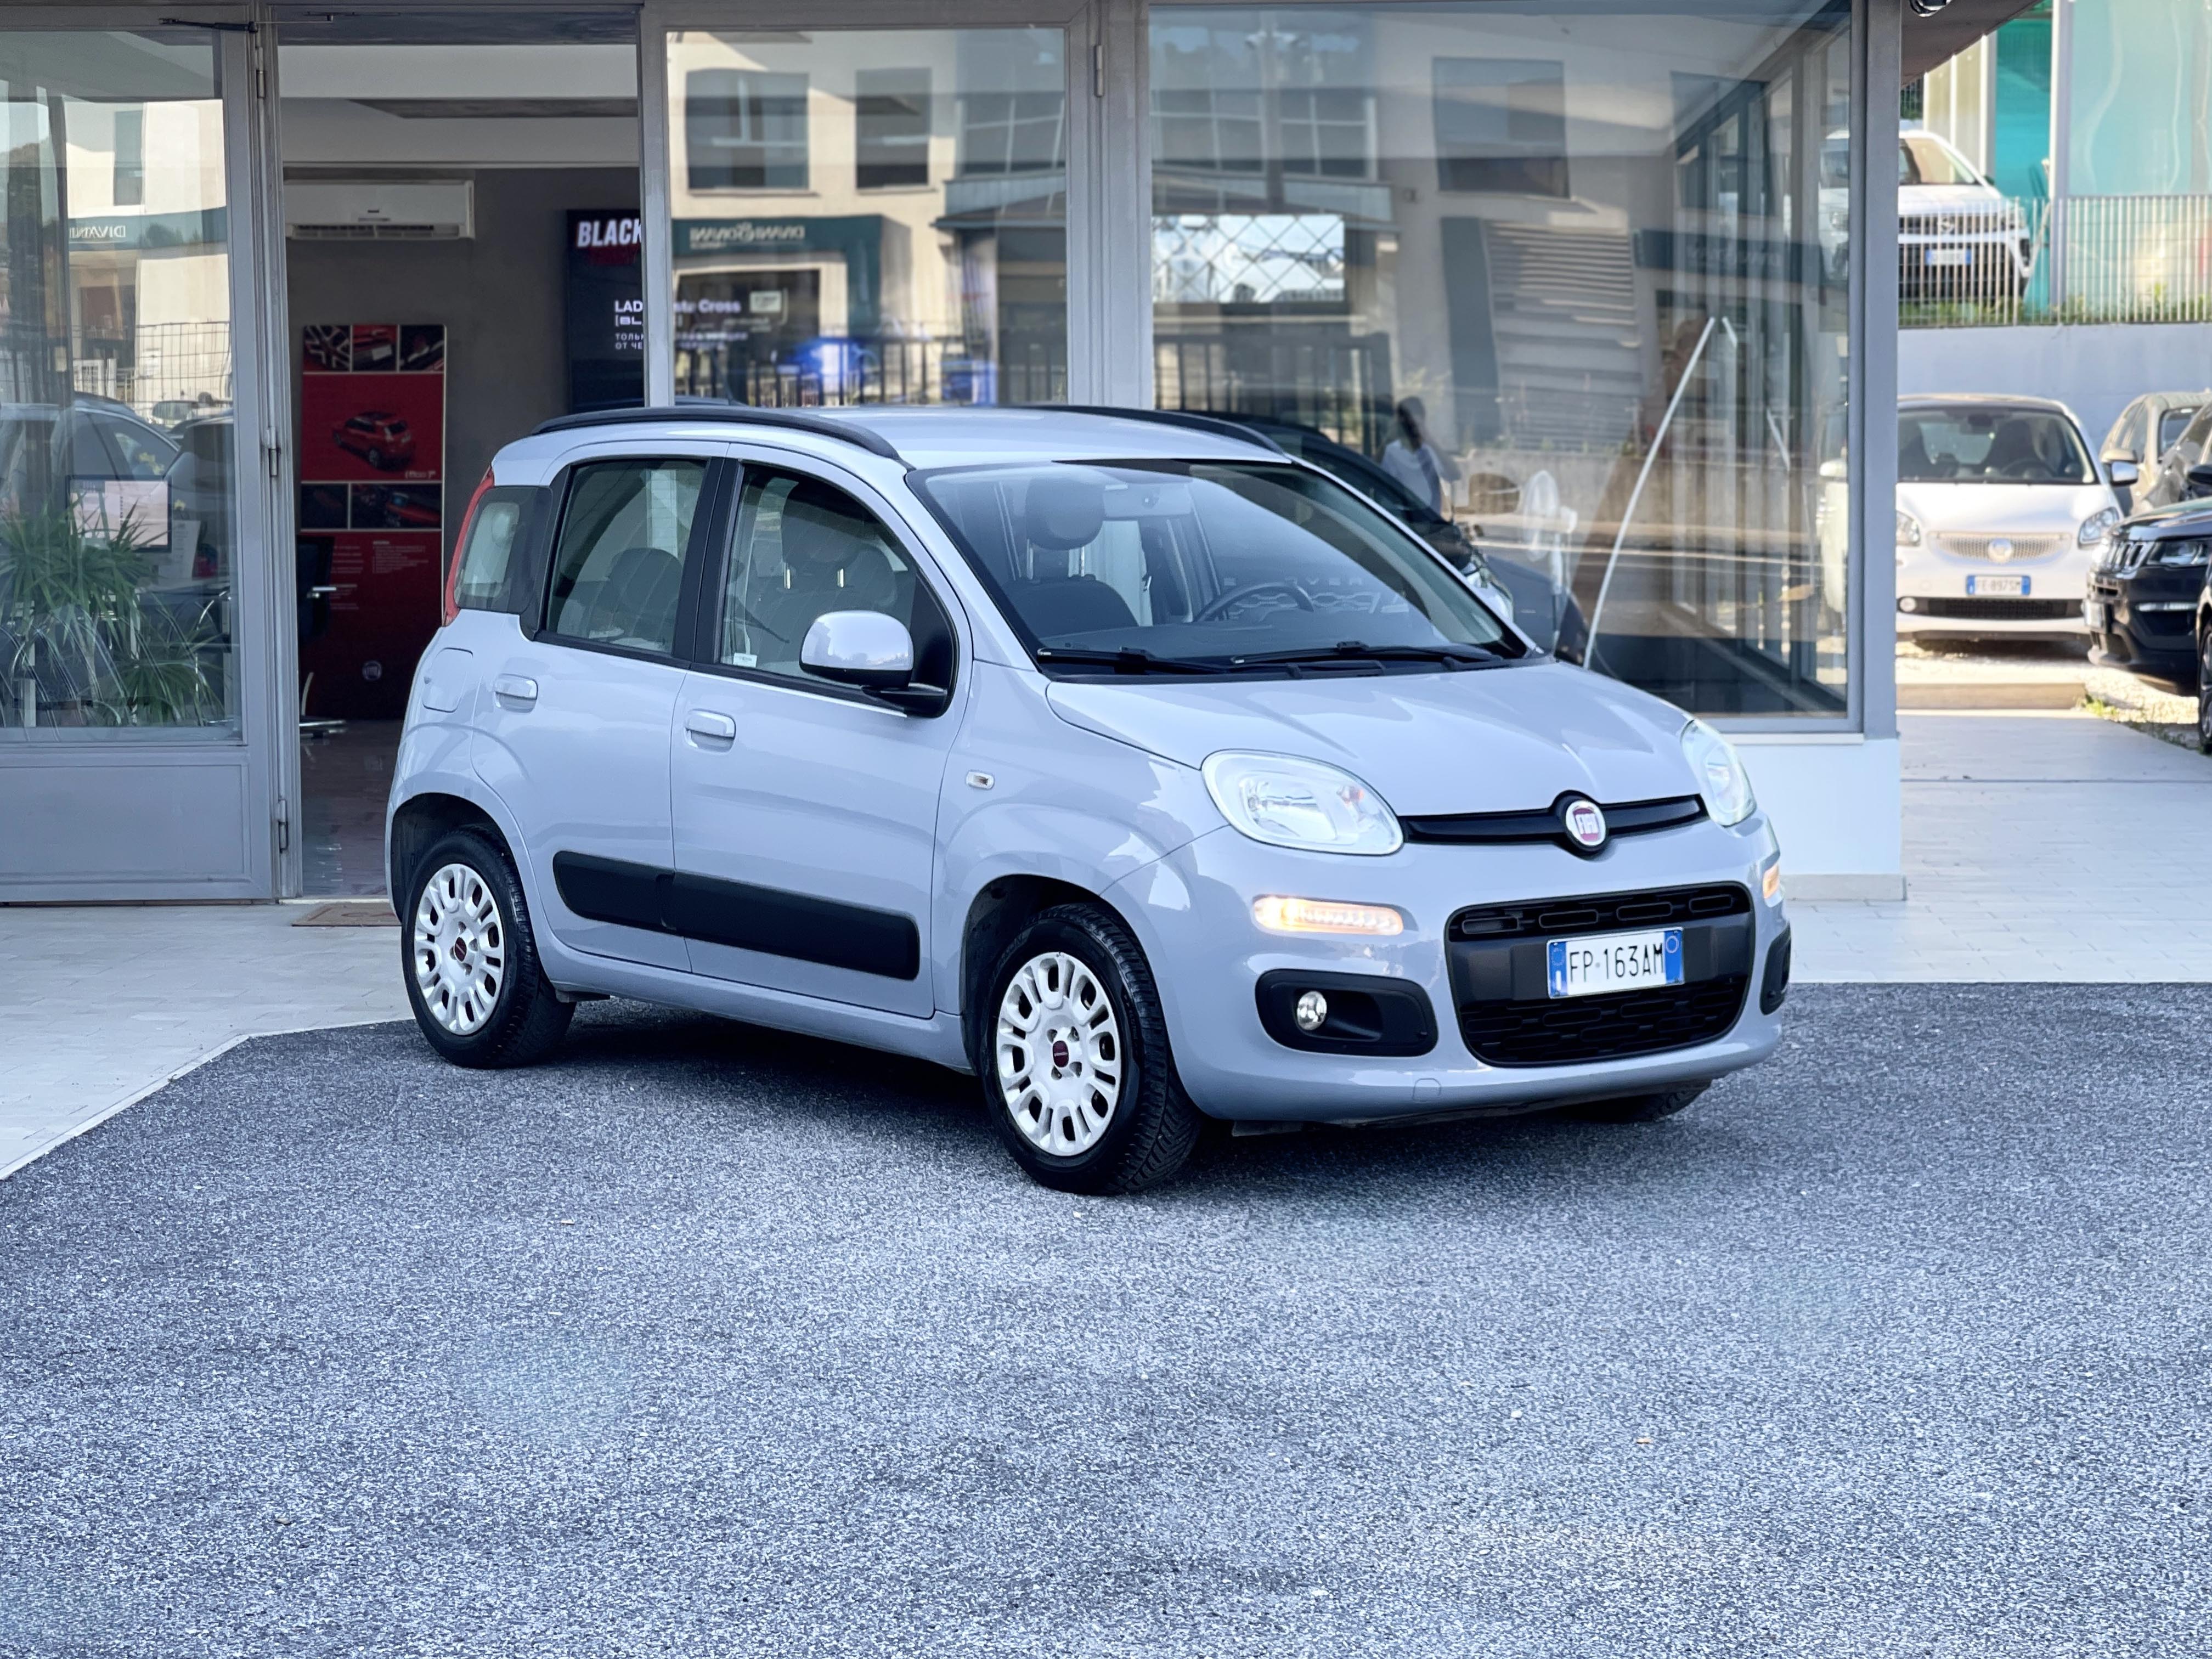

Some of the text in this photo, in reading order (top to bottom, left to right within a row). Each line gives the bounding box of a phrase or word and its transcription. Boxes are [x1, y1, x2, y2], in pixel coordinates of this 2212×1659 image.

[577, 218, 641, 247] BLACK
[615, 300, 643, 312] LAD
[1569, 950, 1593, 983] FP
[1604, 943, 1664, 980] 163AM
